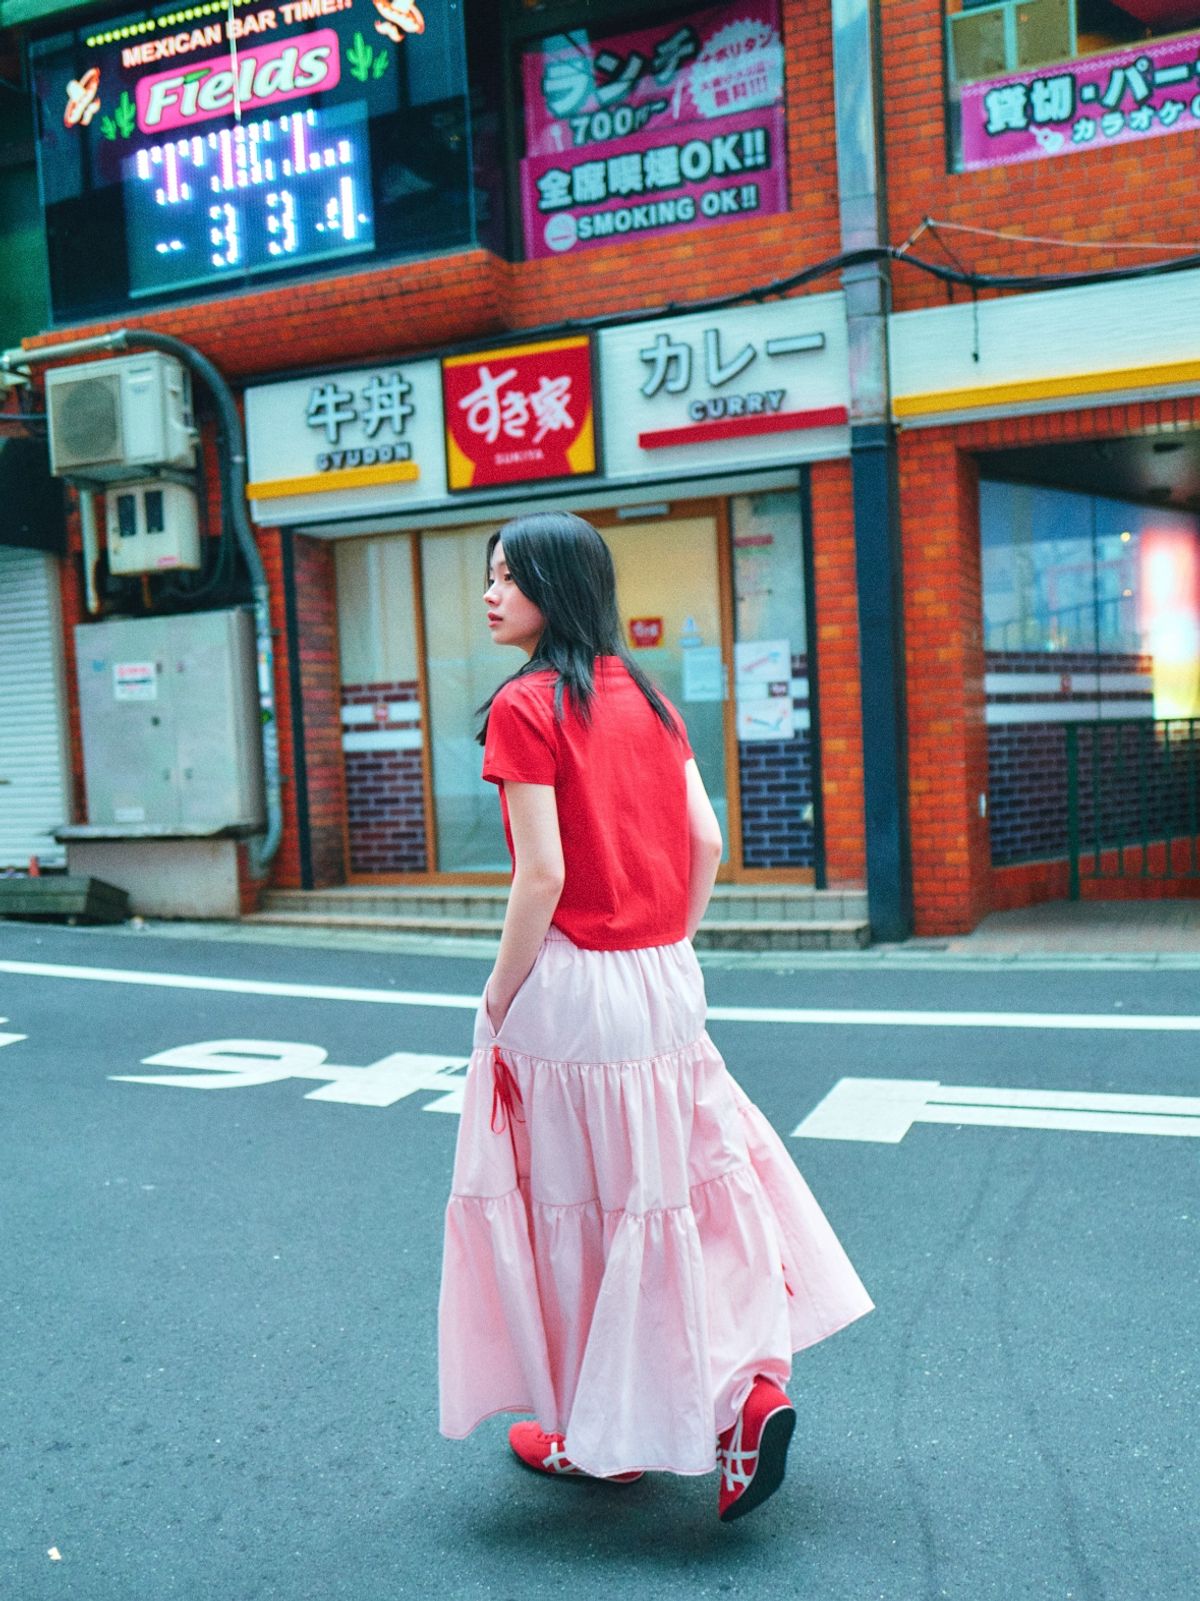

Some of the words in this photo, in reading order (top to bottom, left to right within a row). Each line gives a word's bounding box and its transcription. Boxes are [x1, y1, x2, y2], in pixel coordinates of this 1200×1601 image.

[121, 23, 222, 69] MEXICAN
[226, 10, 278, 39] BAR
[543, 26, 696, 116] ランチ
[145, 45, 331, 126] Fields
[985, 56, 1200, 134] 貸切・パー
[577, 197, 695, 239] SMOKING
[701, 185, 758, 217] OK!!
[639, 327, 826, 398] カレー
[306, 373, 414, 444] 牛丼
[458, 366, 575, 444] すき家
[689, 389, 786, 422] CURRY
[317, 442, 412, 471] GYUDON
